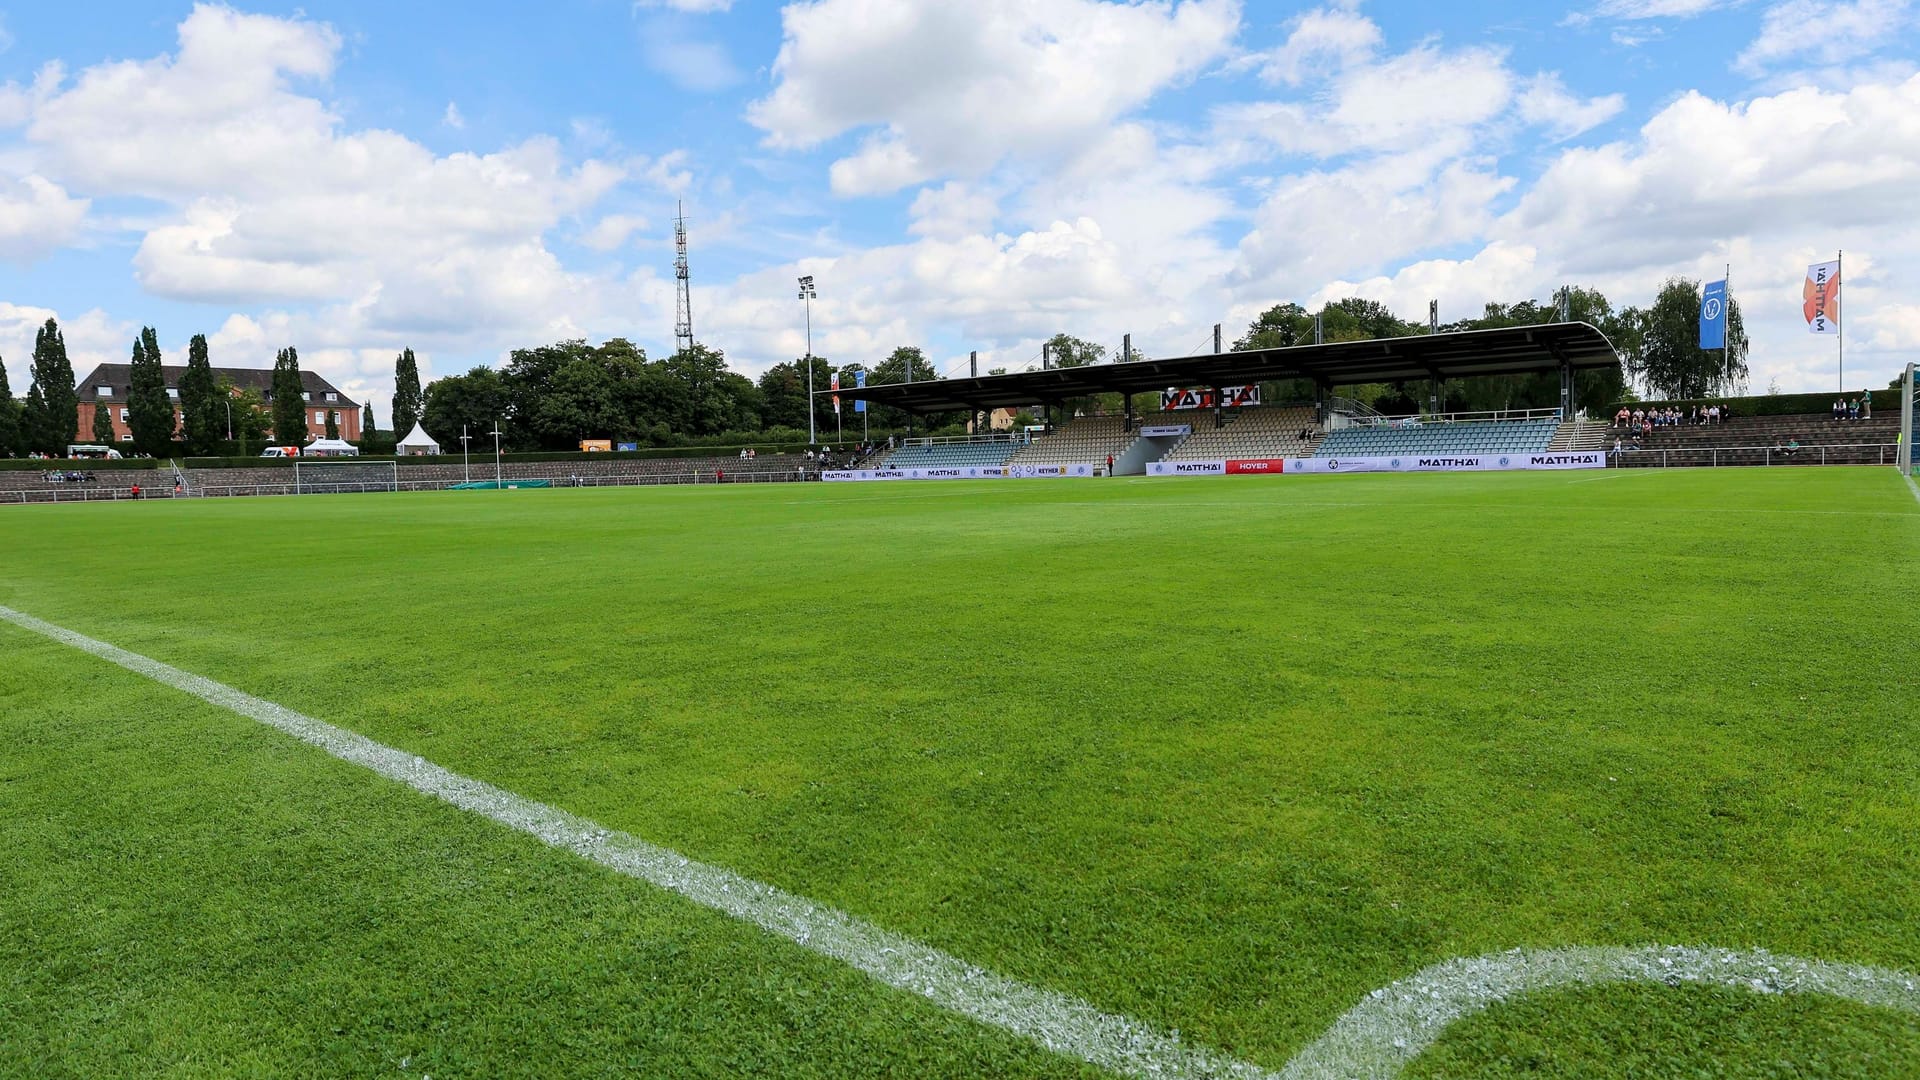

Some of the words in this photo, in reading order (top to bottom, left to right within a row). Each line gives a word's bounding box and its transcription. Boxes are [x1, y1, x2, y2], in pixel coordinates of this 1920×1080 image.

[1419, 458, 1478, 466] MATTHÄI
[1531, 455, 1597, 465] MATTHÄI
[1176, 463, 1221, 471] MATTHÄI
